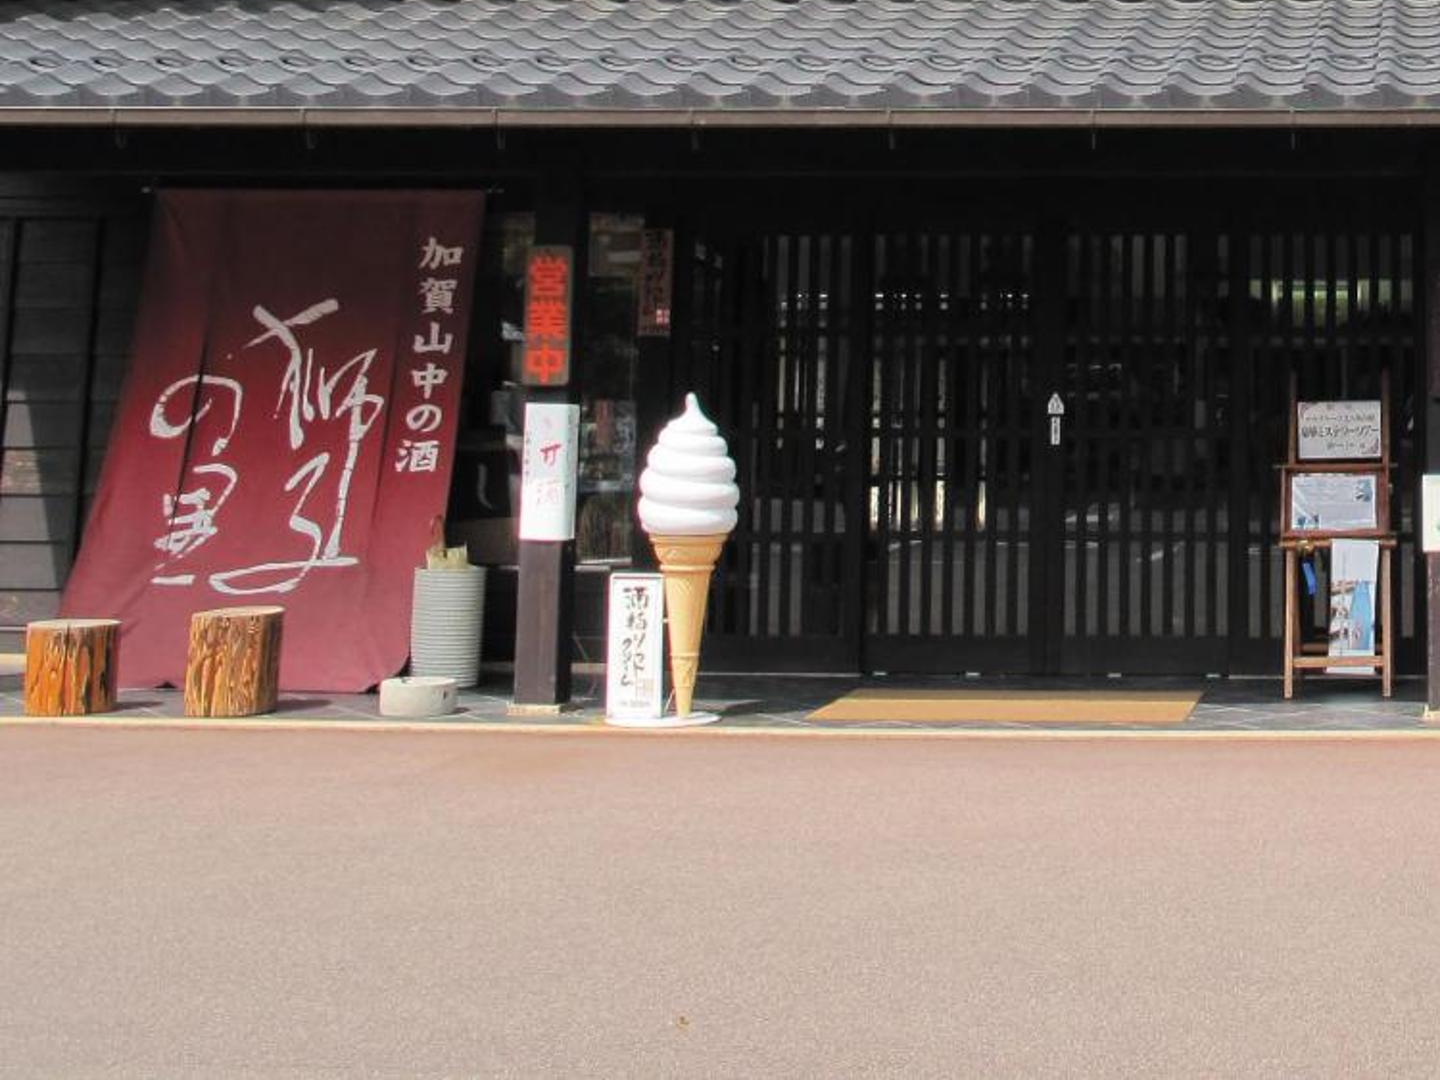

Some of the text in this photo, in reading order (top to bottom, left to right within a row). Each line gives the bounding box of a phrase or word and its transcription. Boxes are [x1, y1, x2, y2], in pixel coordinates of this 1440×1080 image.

[395, 236, 464, 473] 加賀山中の酒
[528, 253, 568, 383] 営業中
